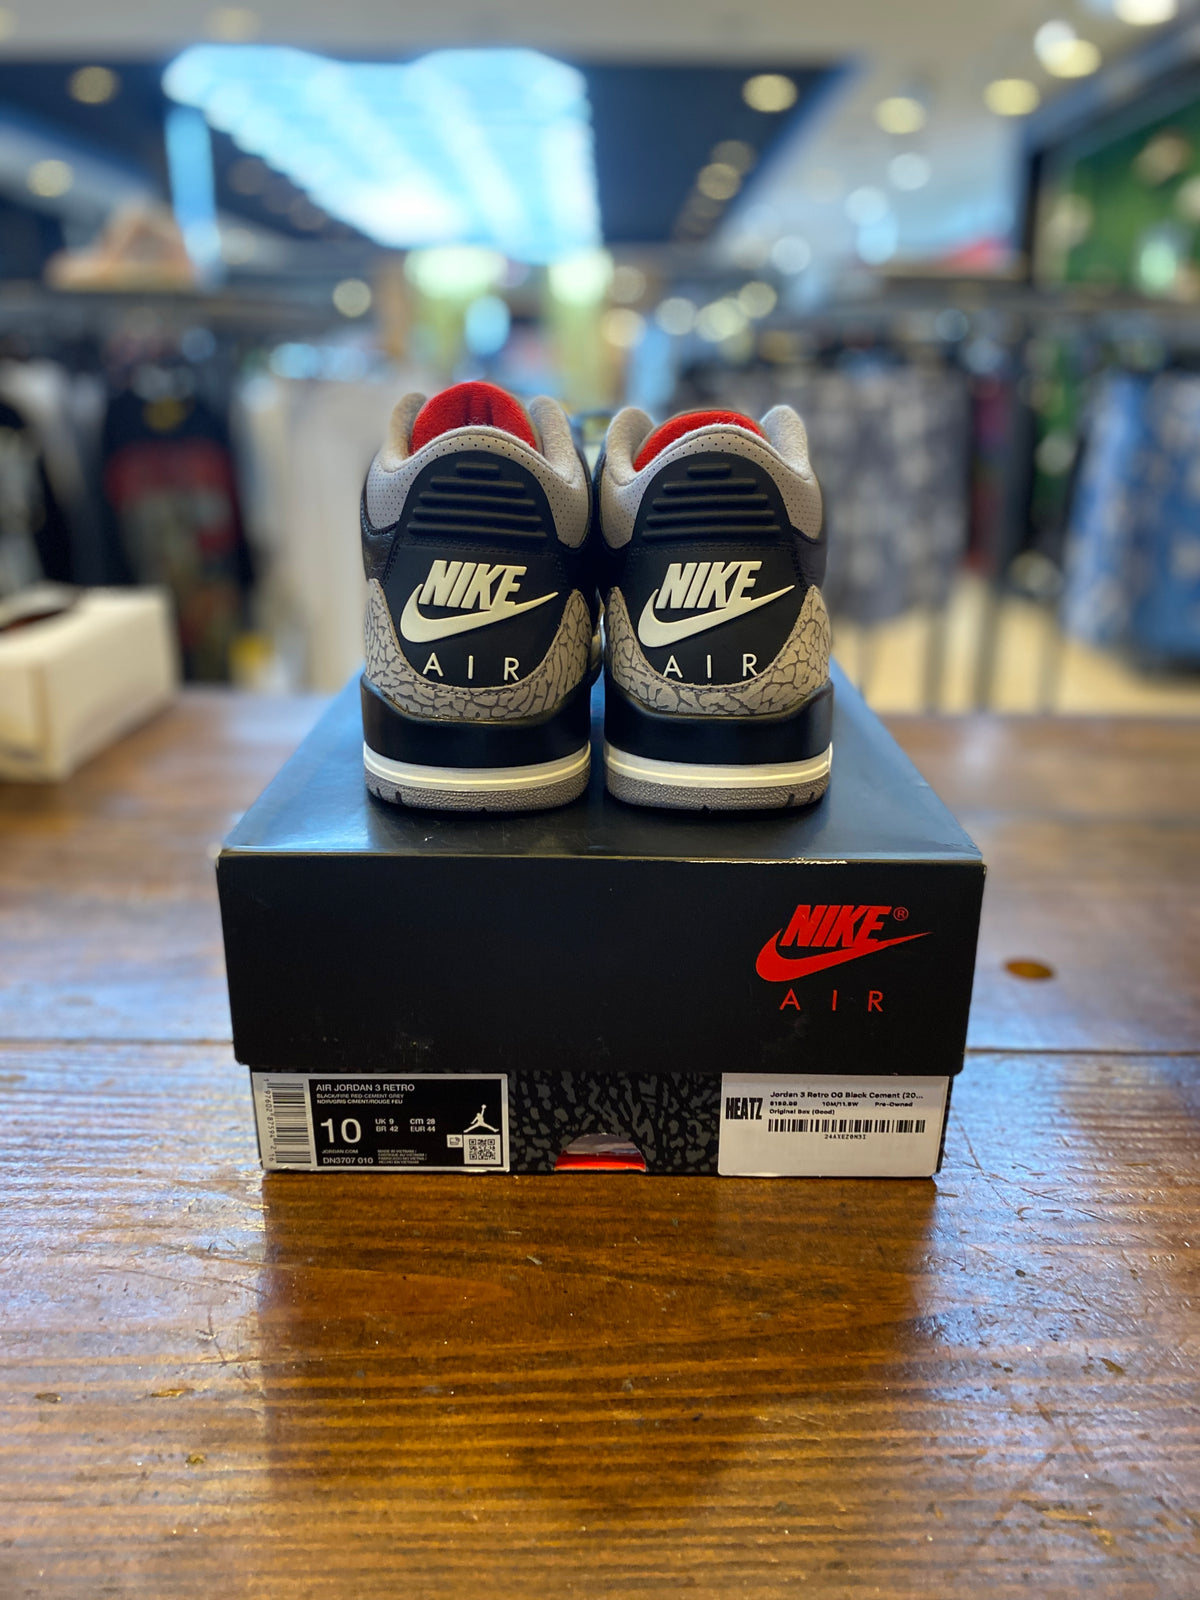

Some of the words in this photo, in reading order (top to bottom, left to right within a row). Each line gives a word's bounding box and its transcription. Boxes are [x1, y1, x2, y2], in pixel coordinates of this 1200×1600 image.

[418, 559, 527, 611] NIKE
[656, 560, 762, 610] NIKE
[422, 653, 521, 681] AIR
[663, 653, 758, 679] AIR
[779, 904, 892, 947] NIKE
[779, 988, 884, 1012] AIR
[264, 1090, 272, 1112] 97602
[316, 1084, 332, 1092] AIR
[333, 1084, 373, 1092] JORDAN
[374, 1084, 381, 1092] 3
[383, 1084, 415, 1092] RETRO
[725, 1097, 763, 1120] HEATZ
[267, 1116, 275, 1138] 87594
[320, 1118, 362, 1144] 10
